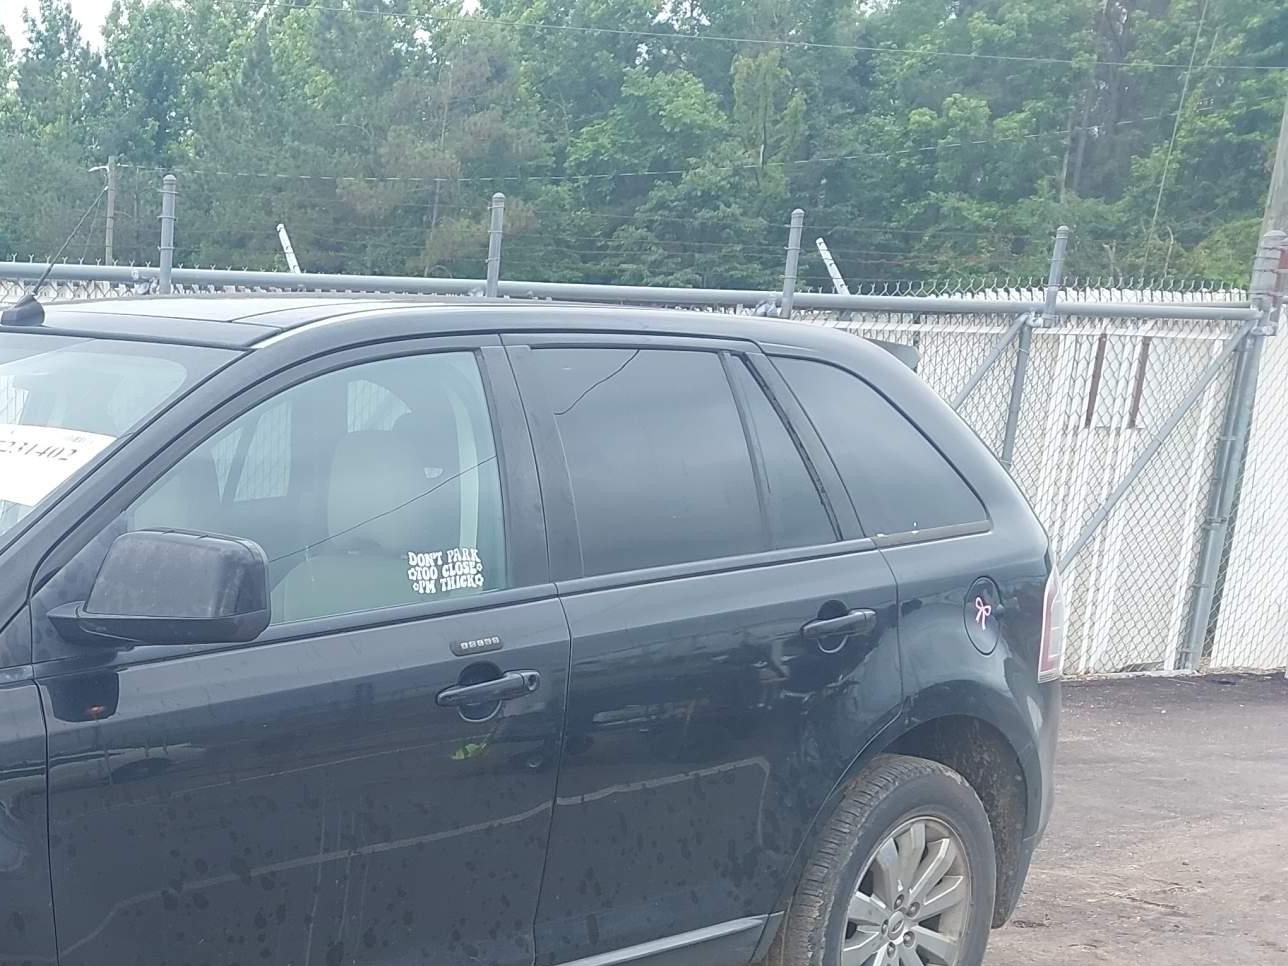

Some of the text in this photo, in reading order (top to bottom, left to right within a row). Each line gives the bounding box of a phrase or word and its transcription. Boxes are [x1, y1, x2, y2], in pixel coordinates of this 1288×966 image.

[408, 548, 482, 567] DON'T PARK
[415, 561, 477, 580] TOO CLOSE
[440, 574, 478, 592] THICK
